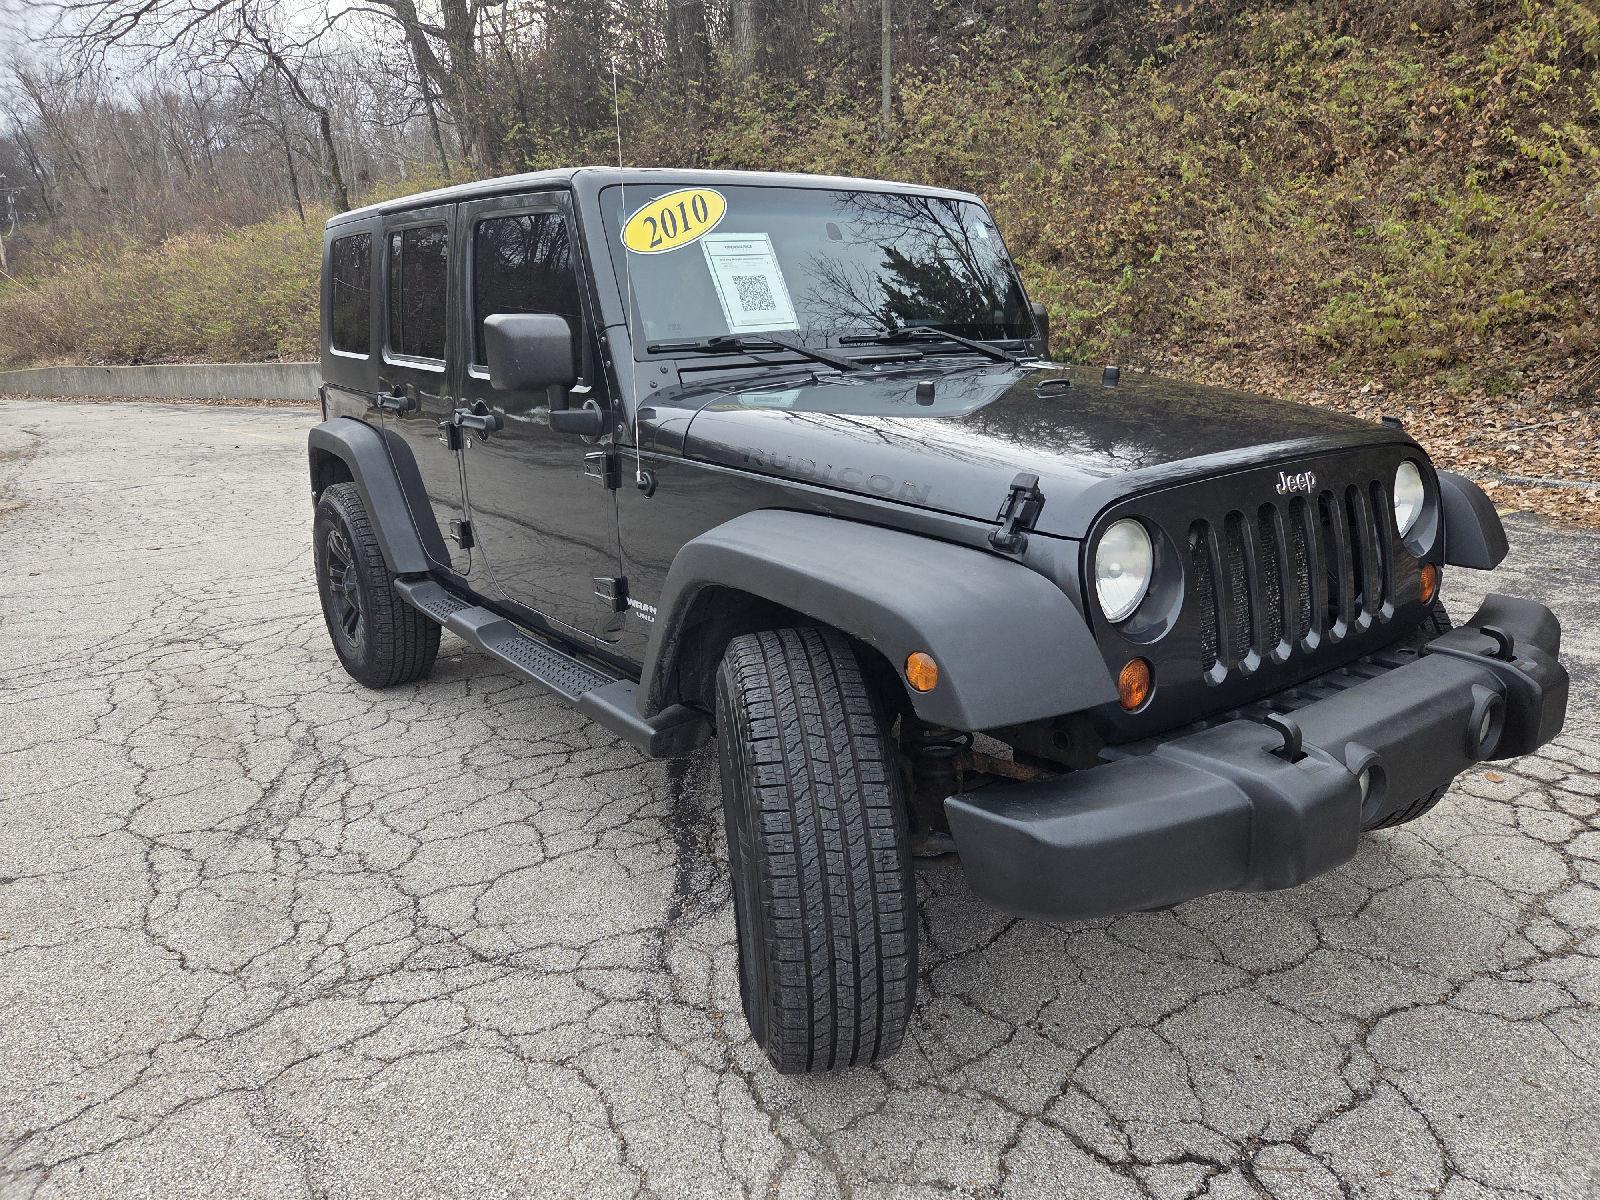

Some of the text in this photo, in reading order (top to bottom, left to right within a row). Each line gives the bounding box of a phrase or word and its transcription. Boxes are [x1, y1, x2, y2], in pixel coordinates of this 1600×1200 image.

[643, 193, 709, 249] 2010
[743, 447, 933, 504] RUBICON
[1275, 470, 1317, 495] Jeep
